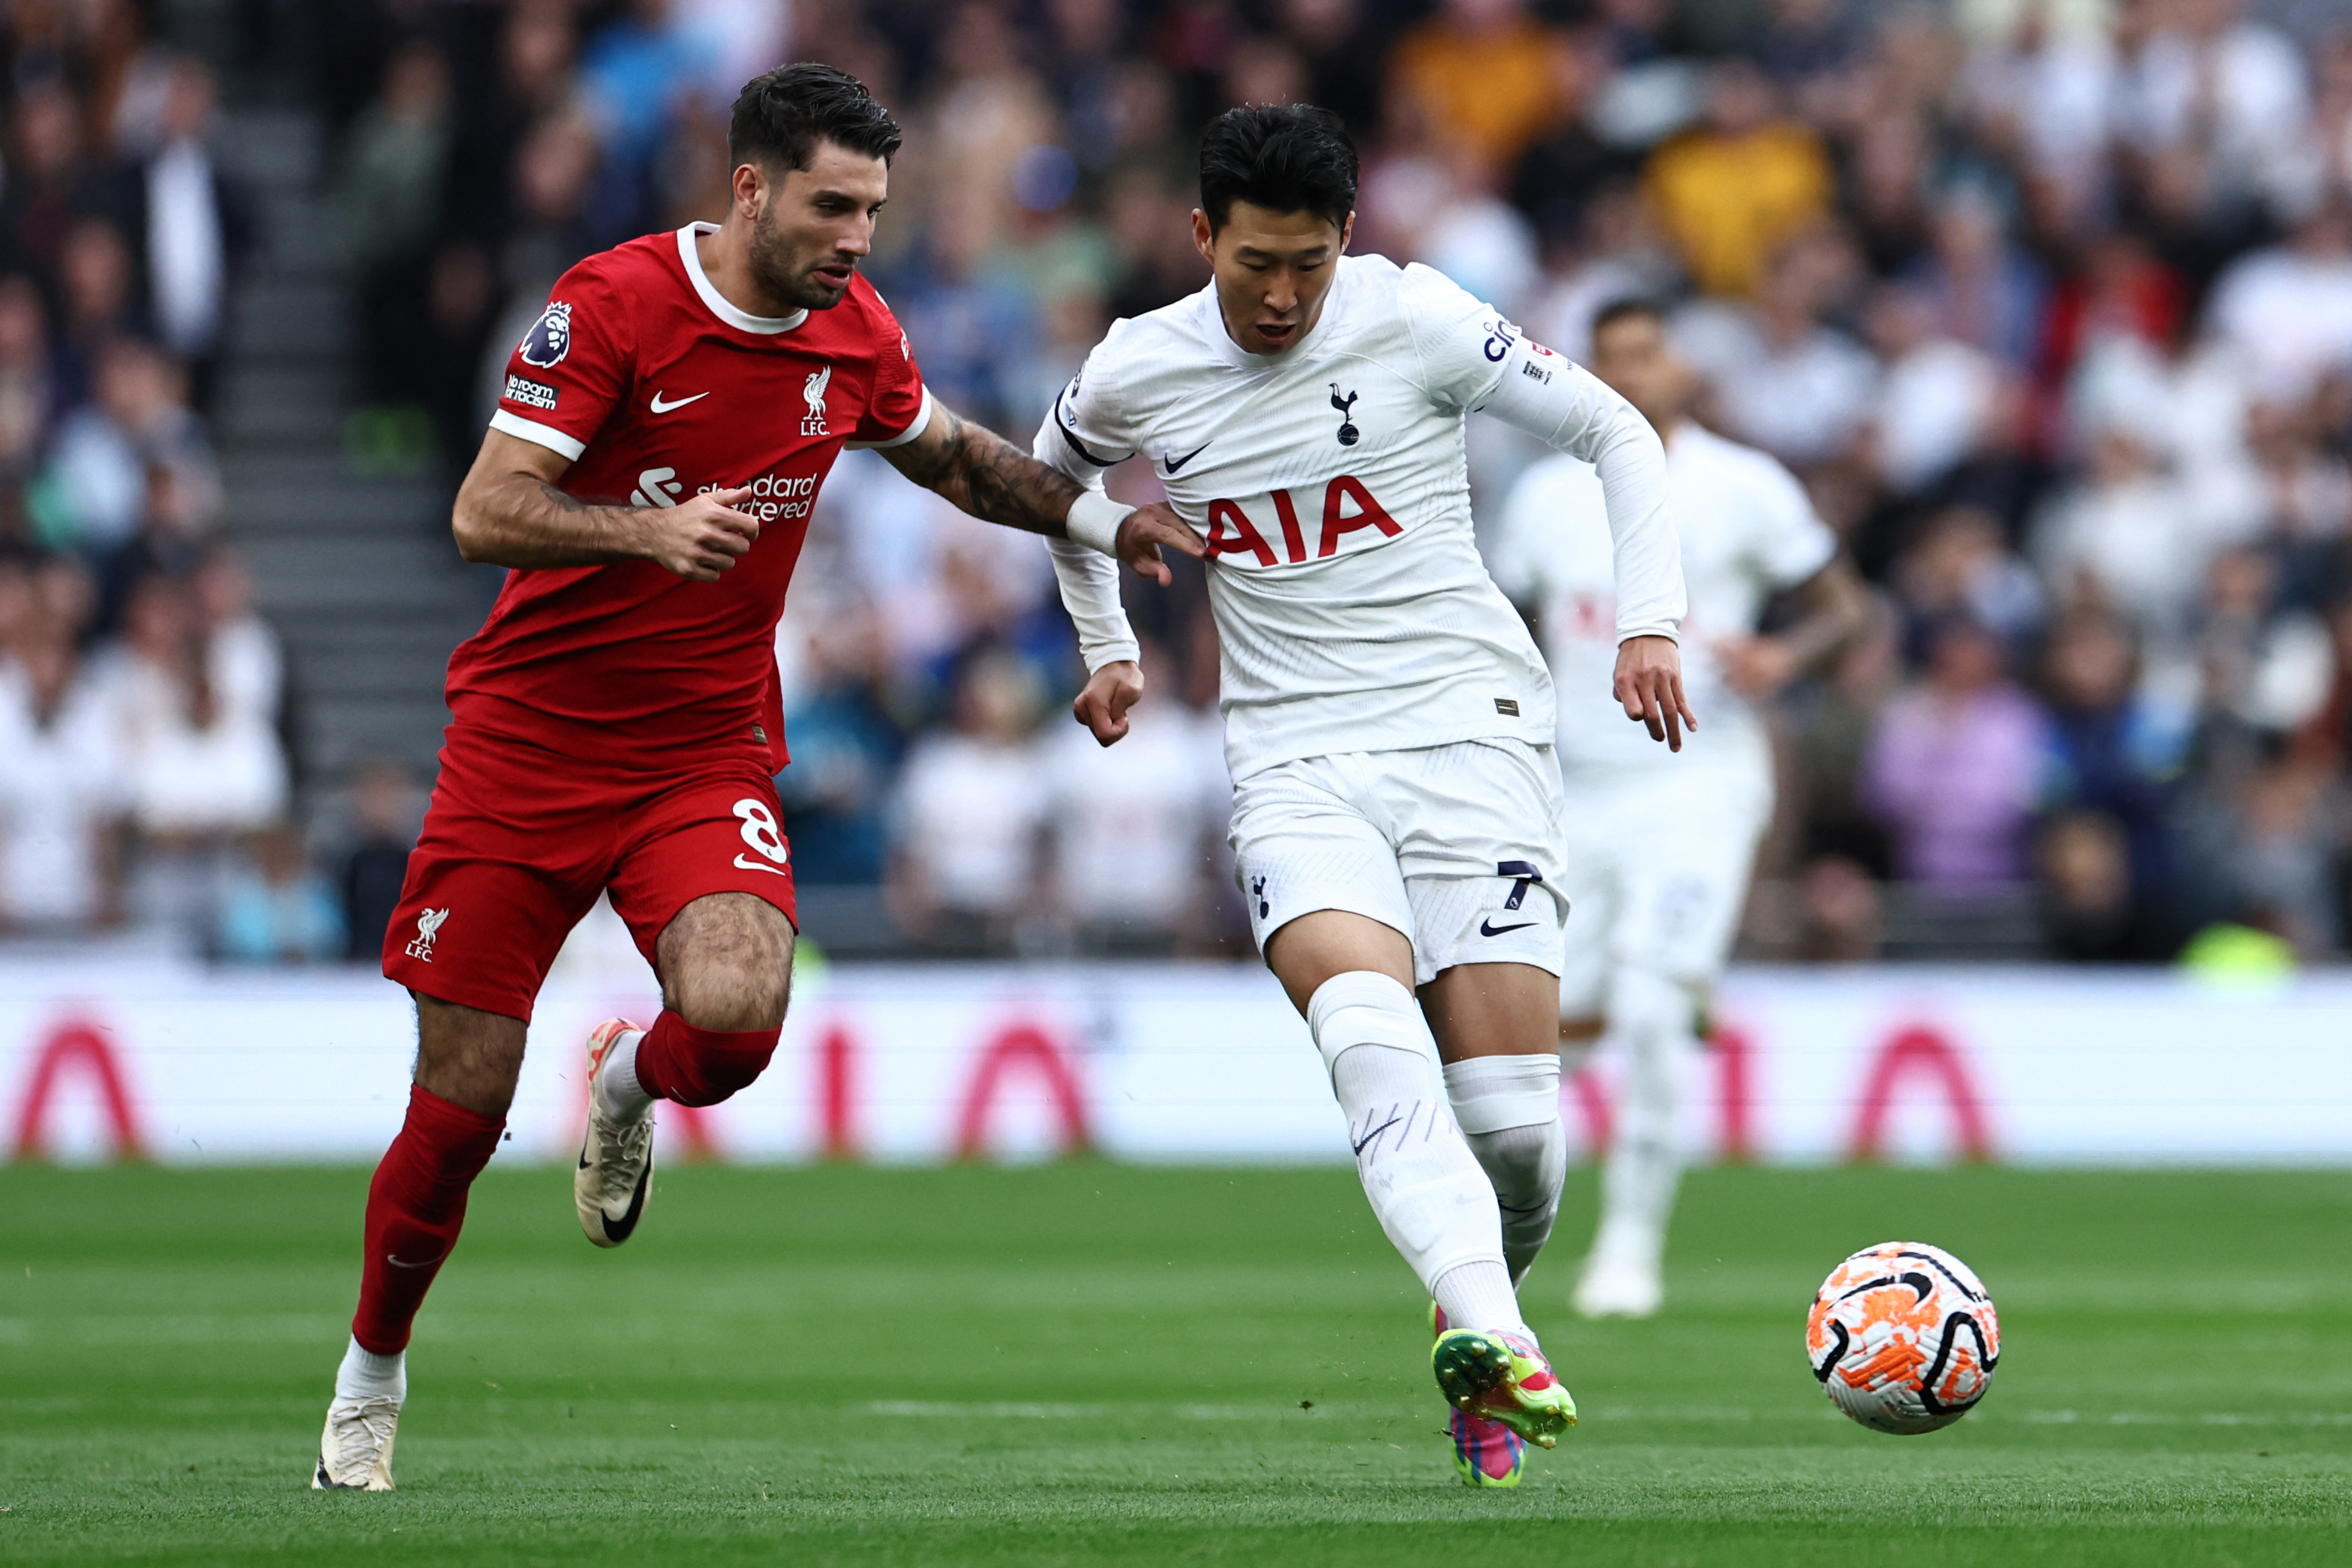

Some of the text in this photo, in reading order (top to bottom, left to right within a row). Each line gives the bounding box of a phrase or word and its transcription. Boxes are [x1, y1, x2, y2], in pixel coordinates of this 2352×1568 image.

[514, 390, 556, 410] racism
[517, 379, 553, 399] room
[1206, 475, 1404, 567] AIA
[732, 798, 788, 864] 8
[1497, 860, 1543, 911] 7
